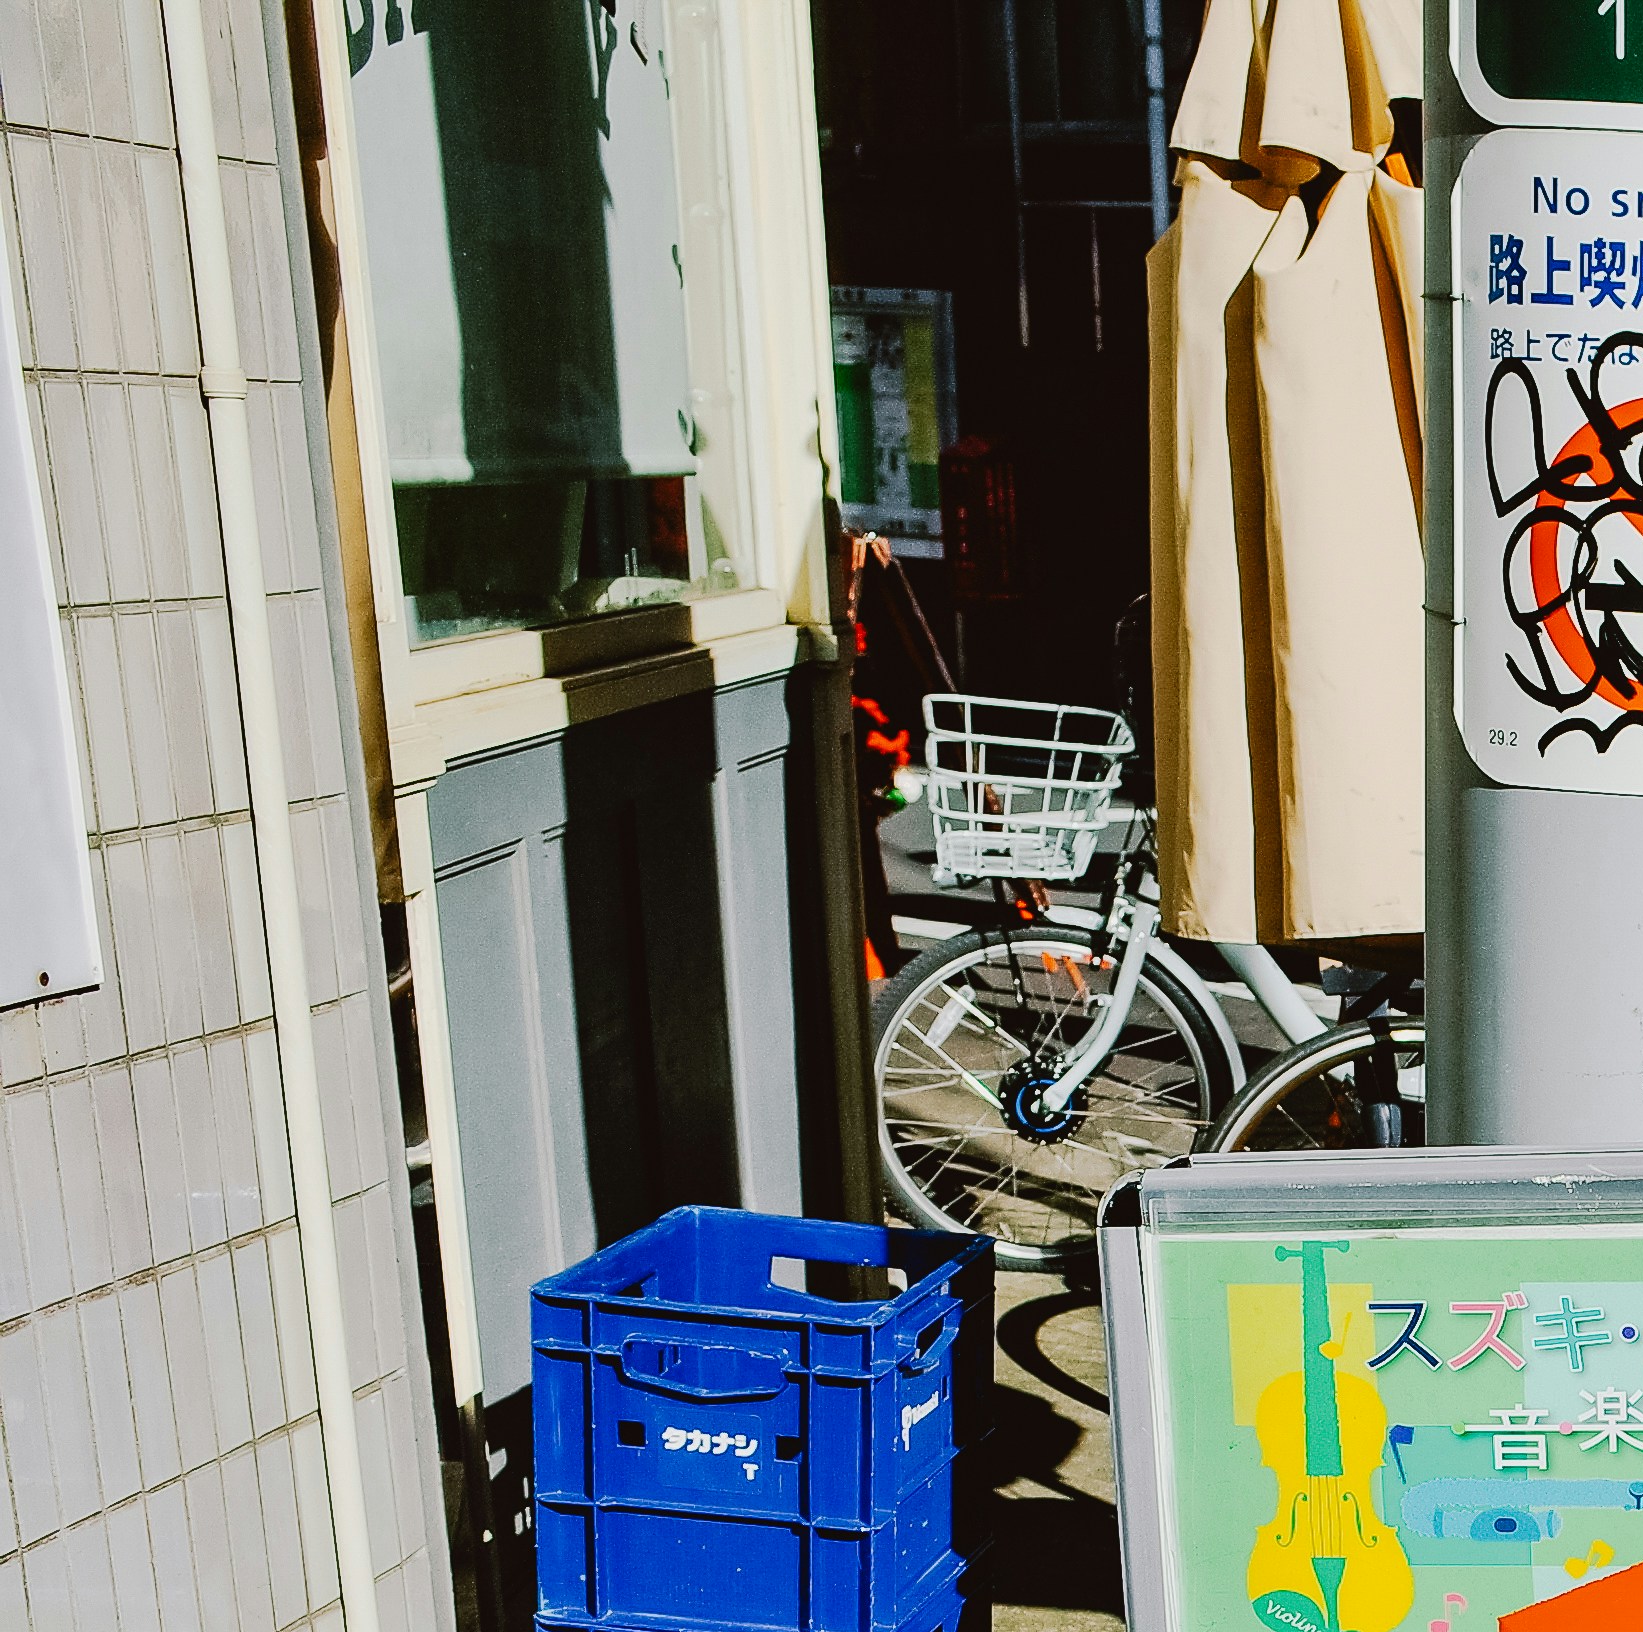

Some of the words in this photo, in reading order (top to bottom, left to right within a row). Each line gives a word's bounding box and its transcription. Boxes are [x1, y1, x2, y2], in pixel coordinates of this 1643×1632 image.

[1534, 177, 1589, 215] No
[1489, 729, 1517, 746] 29.2
[661, 1426, 759, 1458] タカナシ
